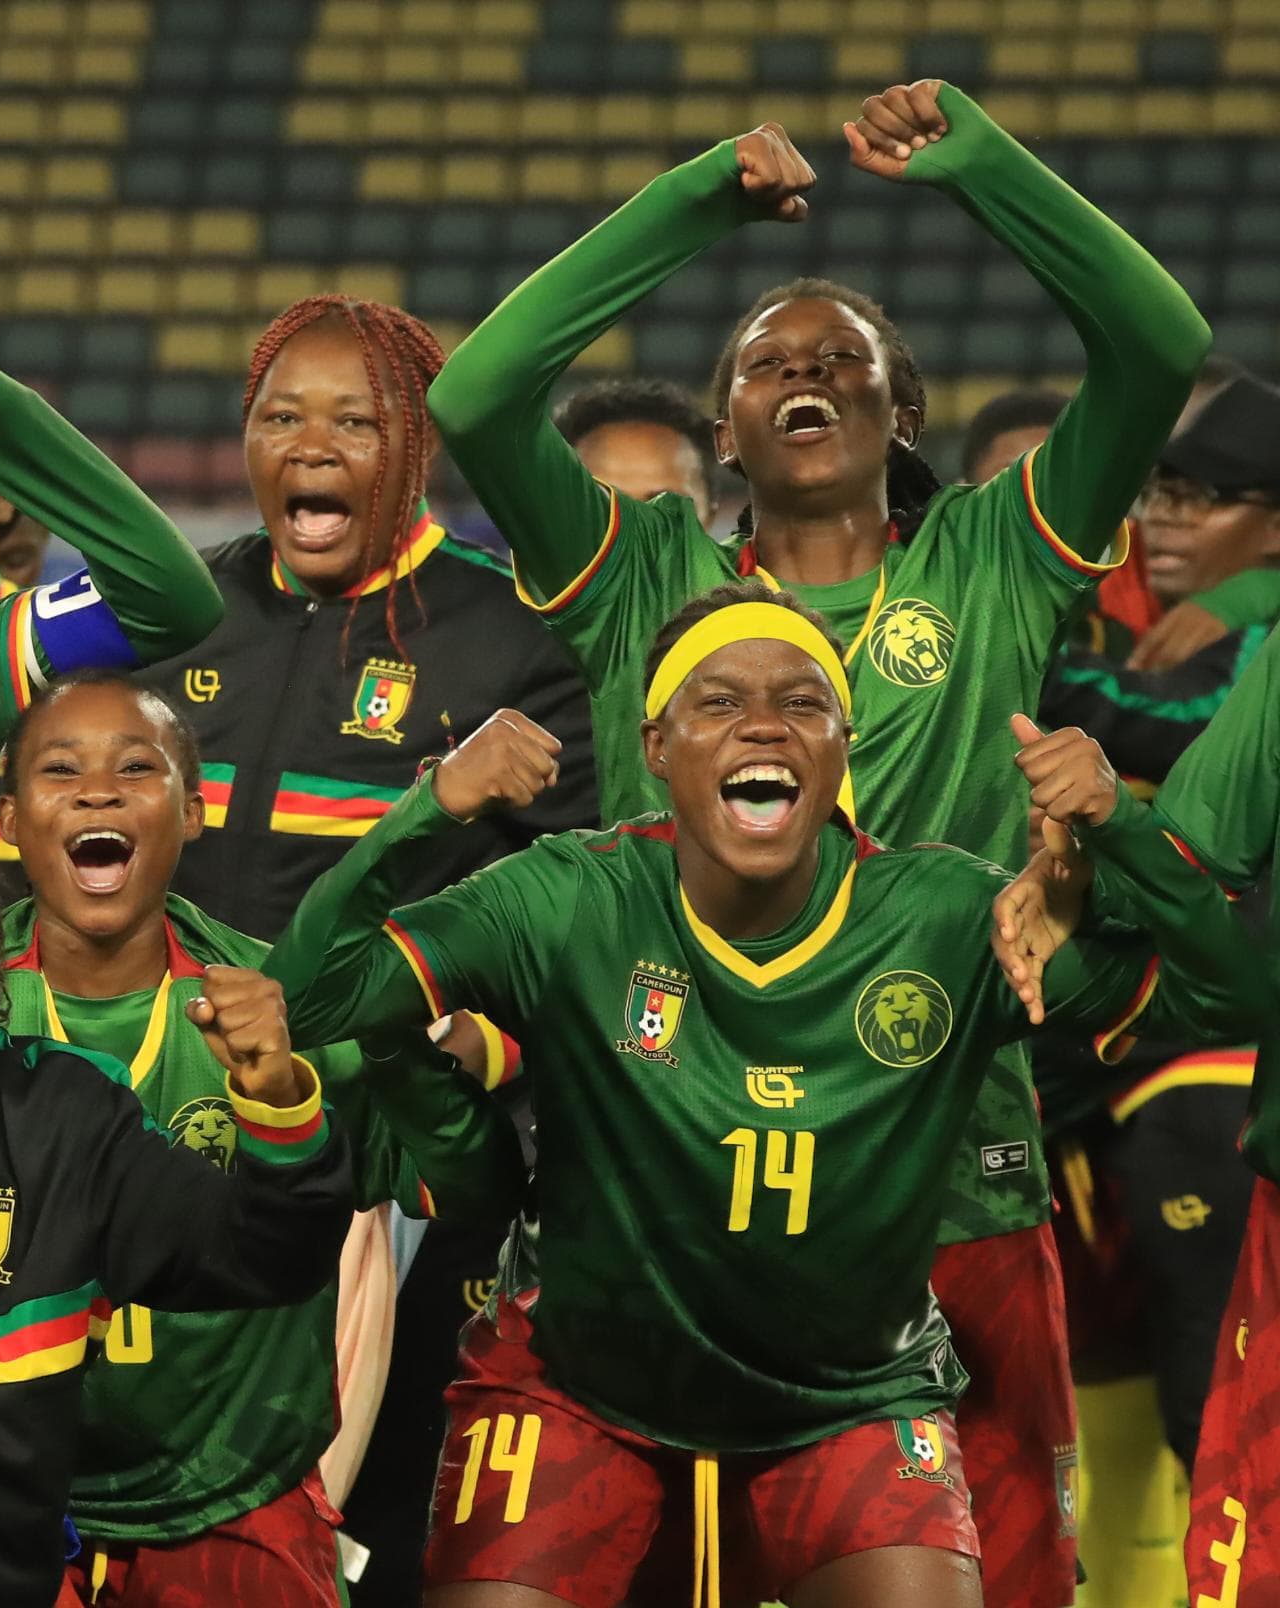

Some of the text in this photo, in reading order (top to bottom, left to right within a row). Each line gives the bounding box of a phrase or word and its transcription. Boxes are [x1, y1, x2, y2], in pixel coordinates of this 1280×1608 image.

[637, 976, 683, 995] CAMEROUN
[630, 1043, 668, 1058] FECAFOOT
[746, 1065, 804, 1074] FOURTEEN
[720, 1127, 816, 1235] 14
[455, 1413, 542, 1524] 14
[1197, 1496, 1247, 1608] 3
